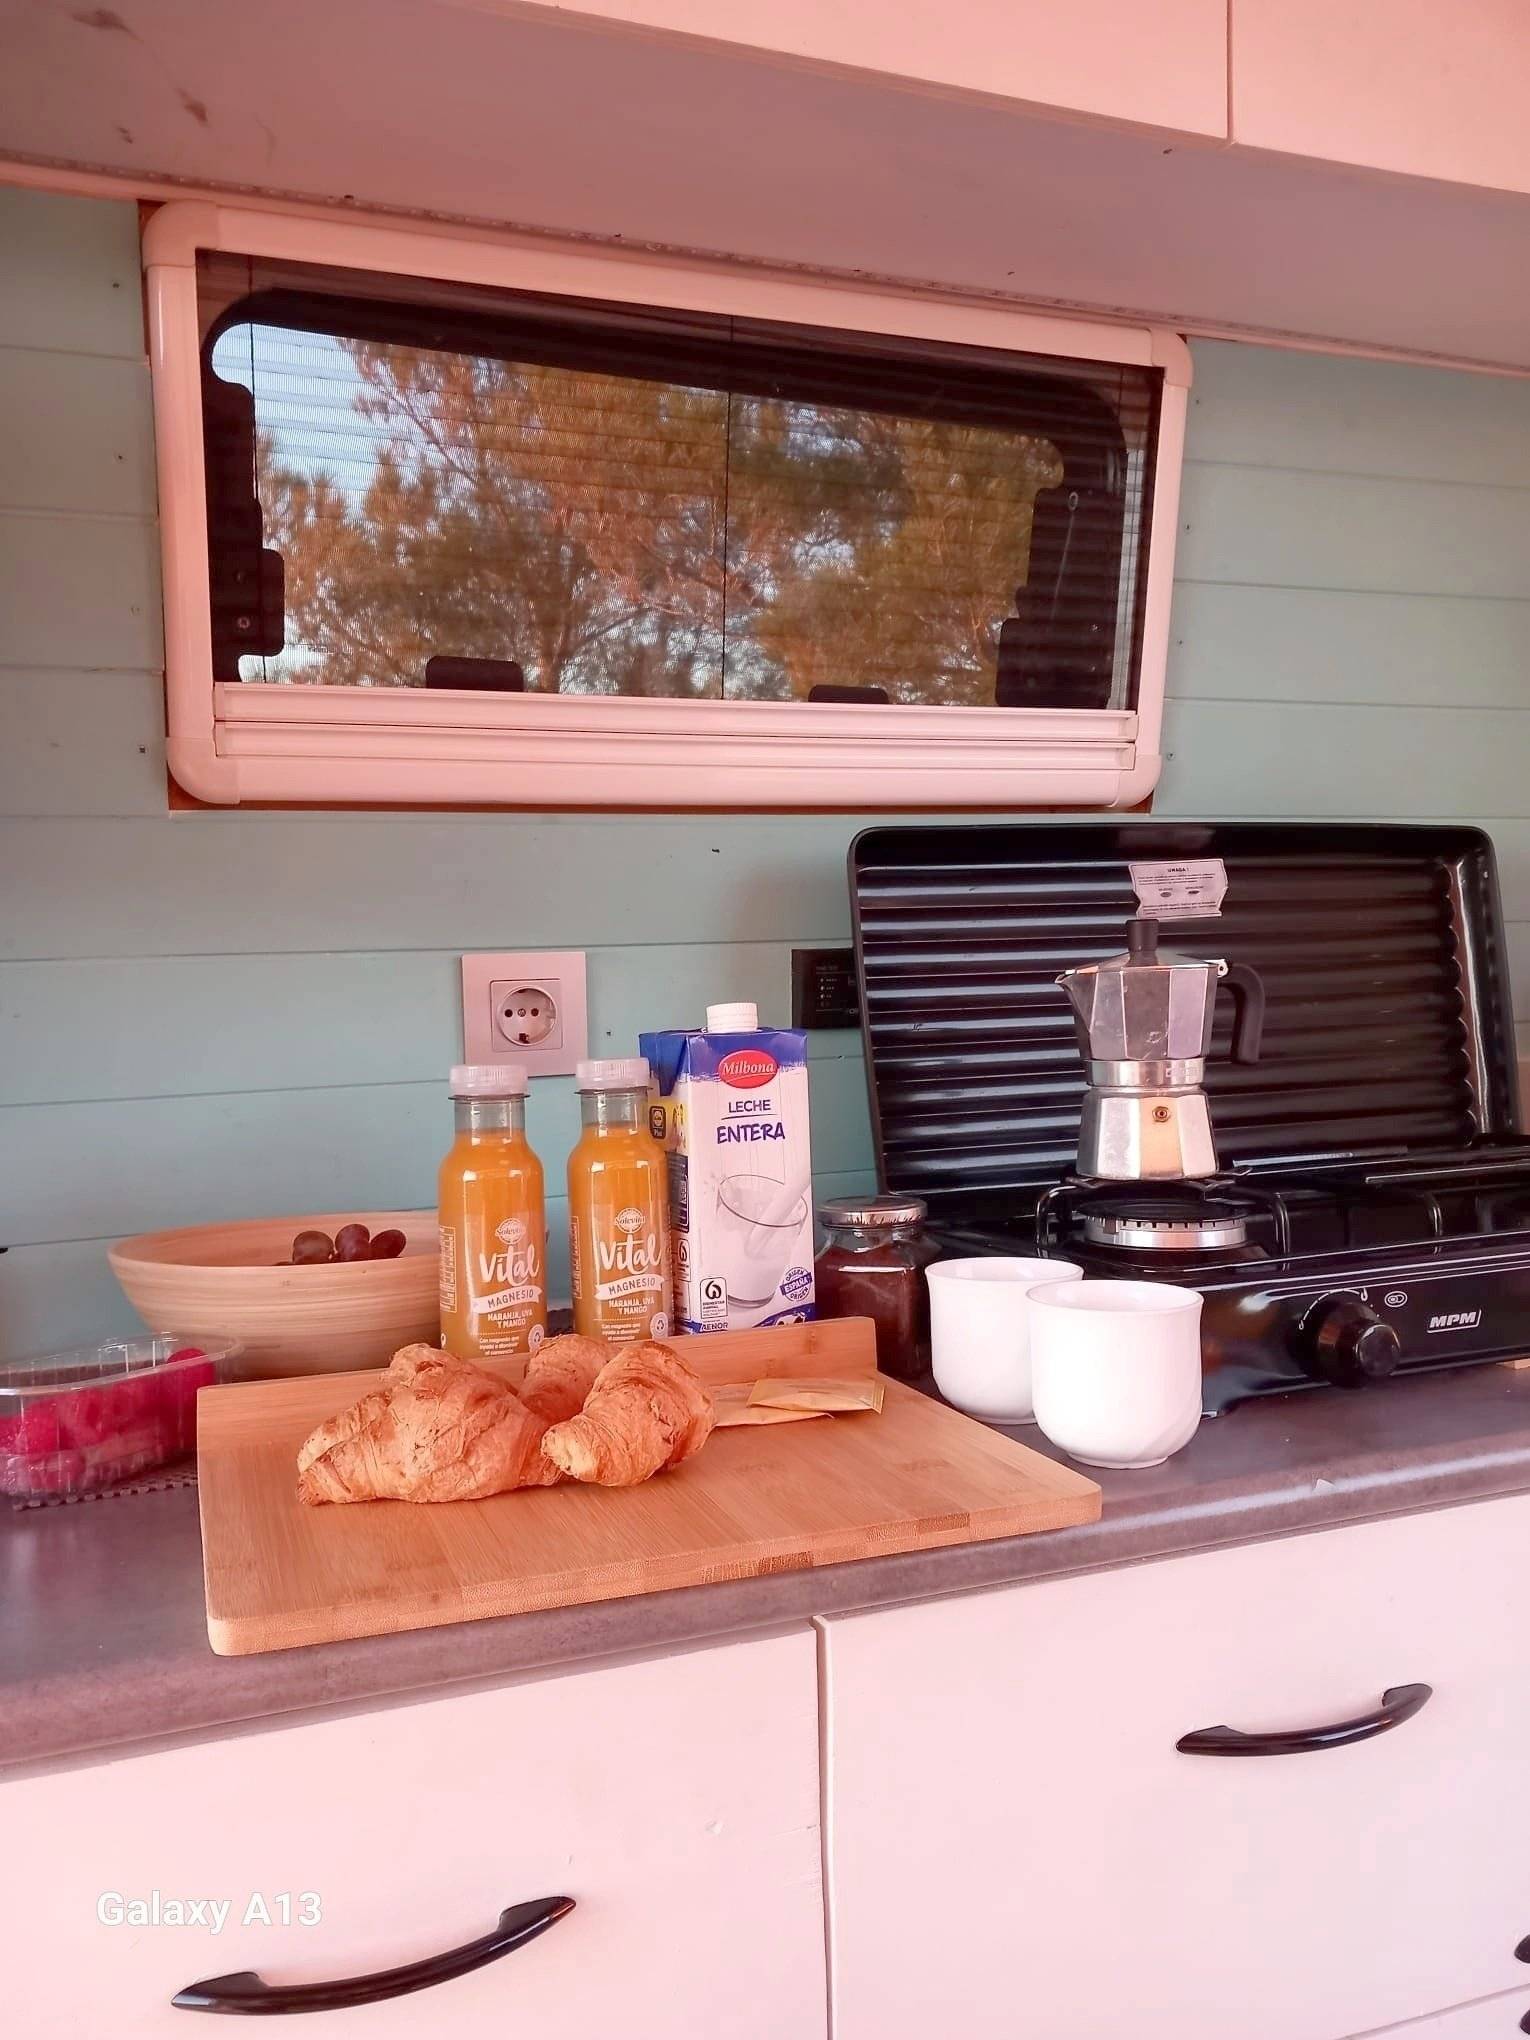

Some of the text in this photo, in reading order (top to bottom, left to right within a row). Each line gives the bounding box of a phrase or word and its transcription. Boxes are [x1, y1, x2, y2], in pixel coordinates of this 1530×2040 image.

[722, 1060, 775, 1076] Milbona
[728, 1100, 772, 1114] LECHE
[717, 1122, 786, 1145] ENTERA
[600, 1233, 662, 1275] Vital
[479, 1244, 541, 1287] Vital
[608, 1277, 656, 1296] MAGNESIO
[487, 1289, 534, 1309] MAGNESIO
[624, 1305, 648, 1315] MANGO
[503, 1318, 526, 1328] MANGO
[702, 1322, 729, 1331] AENOR
[1429, 1311, 1477, 1329] MPM
